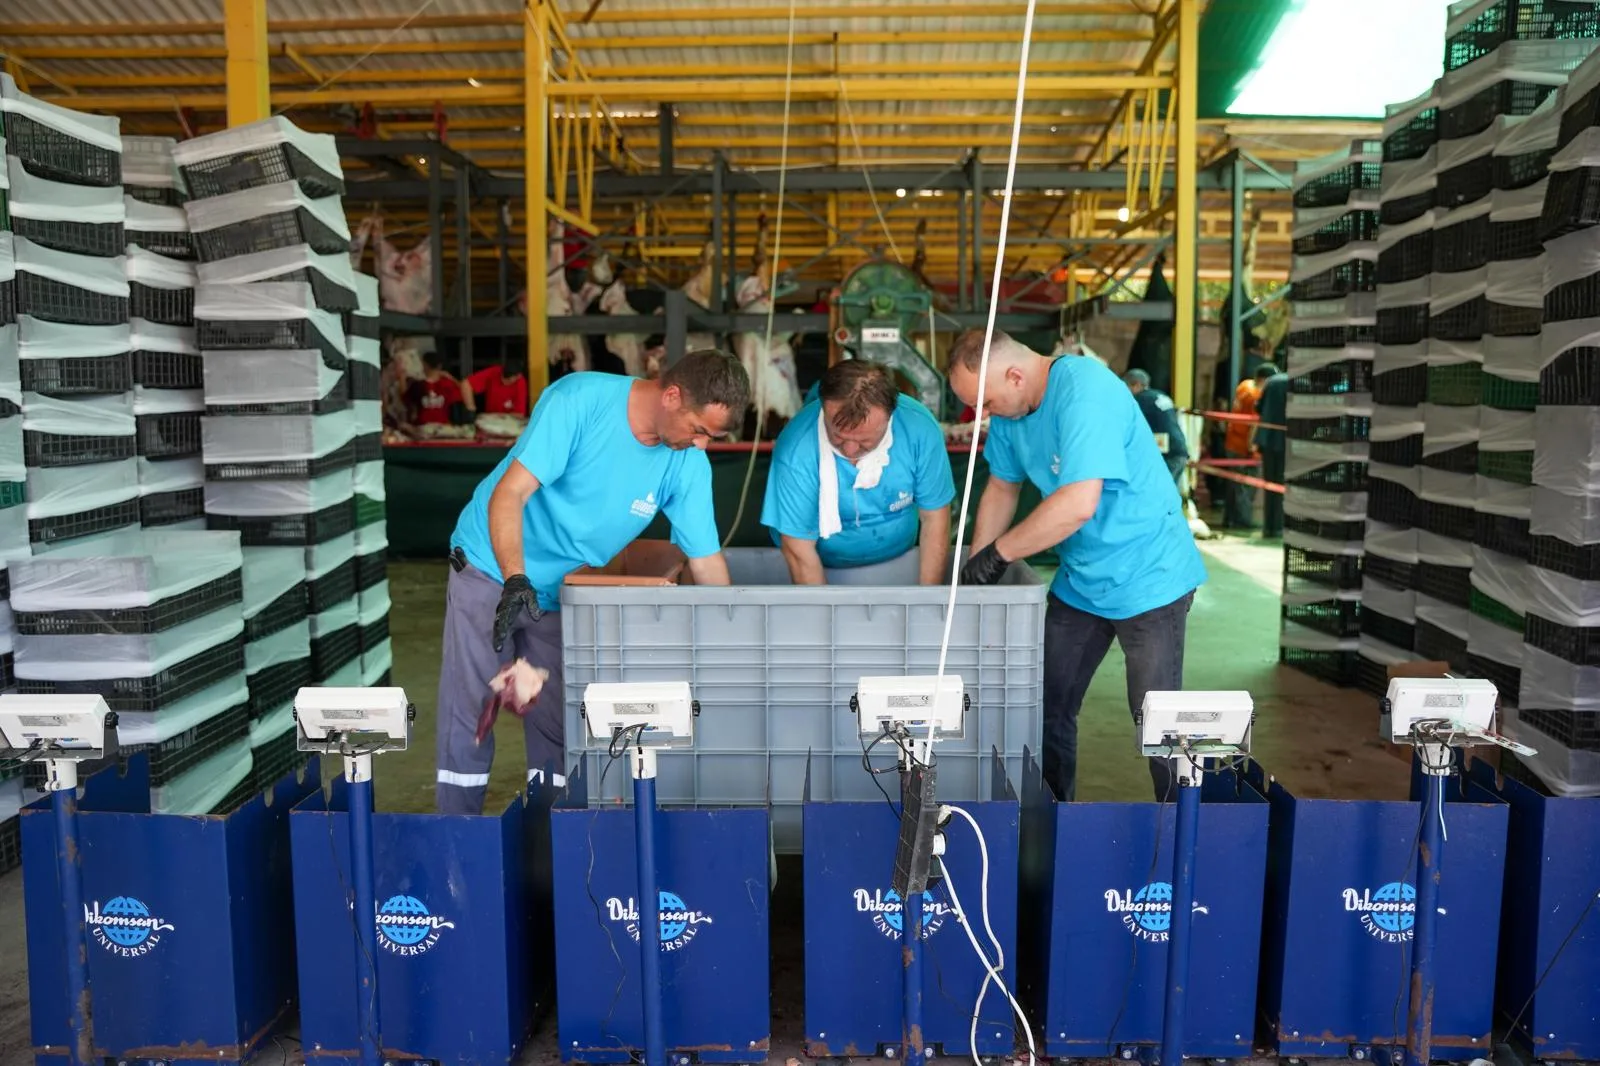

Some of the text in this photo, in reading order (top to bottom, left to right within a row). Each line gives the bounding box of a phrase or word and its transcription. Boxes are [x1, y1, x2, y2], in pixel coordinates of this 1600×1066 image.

[606, 898, 712, 924] Diksan
[853, 889, 958, 915] Dikoan
[1104, 889, 1208, 914] Dikoms
[1342, 888, 1446, 914] Dikomsa
[873, 915, 943, 940] UNIVSAL
[1123, 915, 1169, 942] UNIVER
[1360, 914, 1414, 943] UNIVERS
[93, 927, 160, 957] UNIVERSAL
